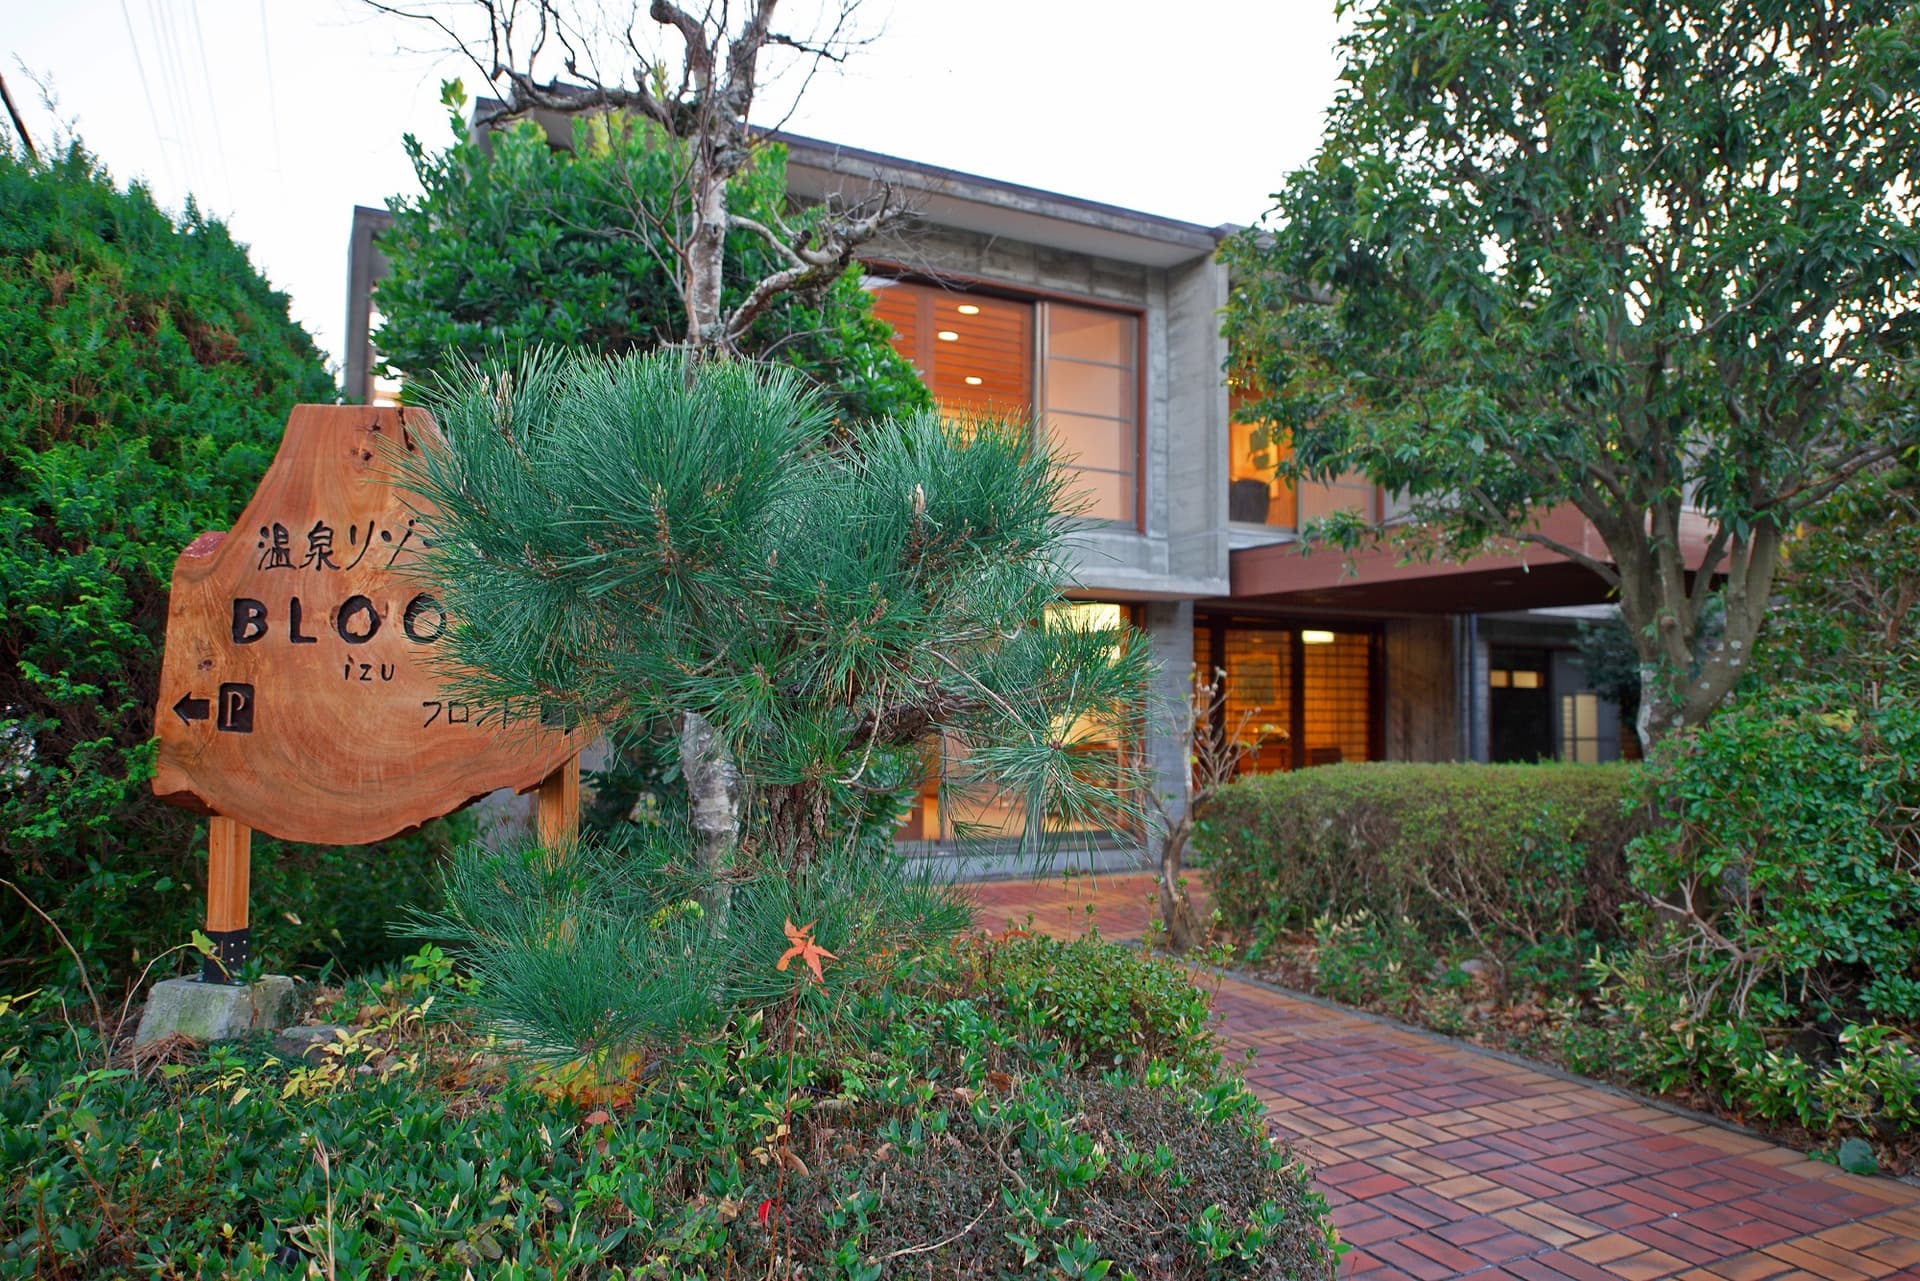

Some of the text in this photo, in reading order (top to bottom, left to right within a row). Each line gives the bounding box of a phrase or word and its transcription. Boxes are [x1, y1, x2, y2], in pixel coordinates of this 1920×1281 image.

[232, 592, 447, 645] BLOO
[344, 654, 394, 681] izu
[223, 689, 247, 728] P
[422, 698, 522, 730] フロント
